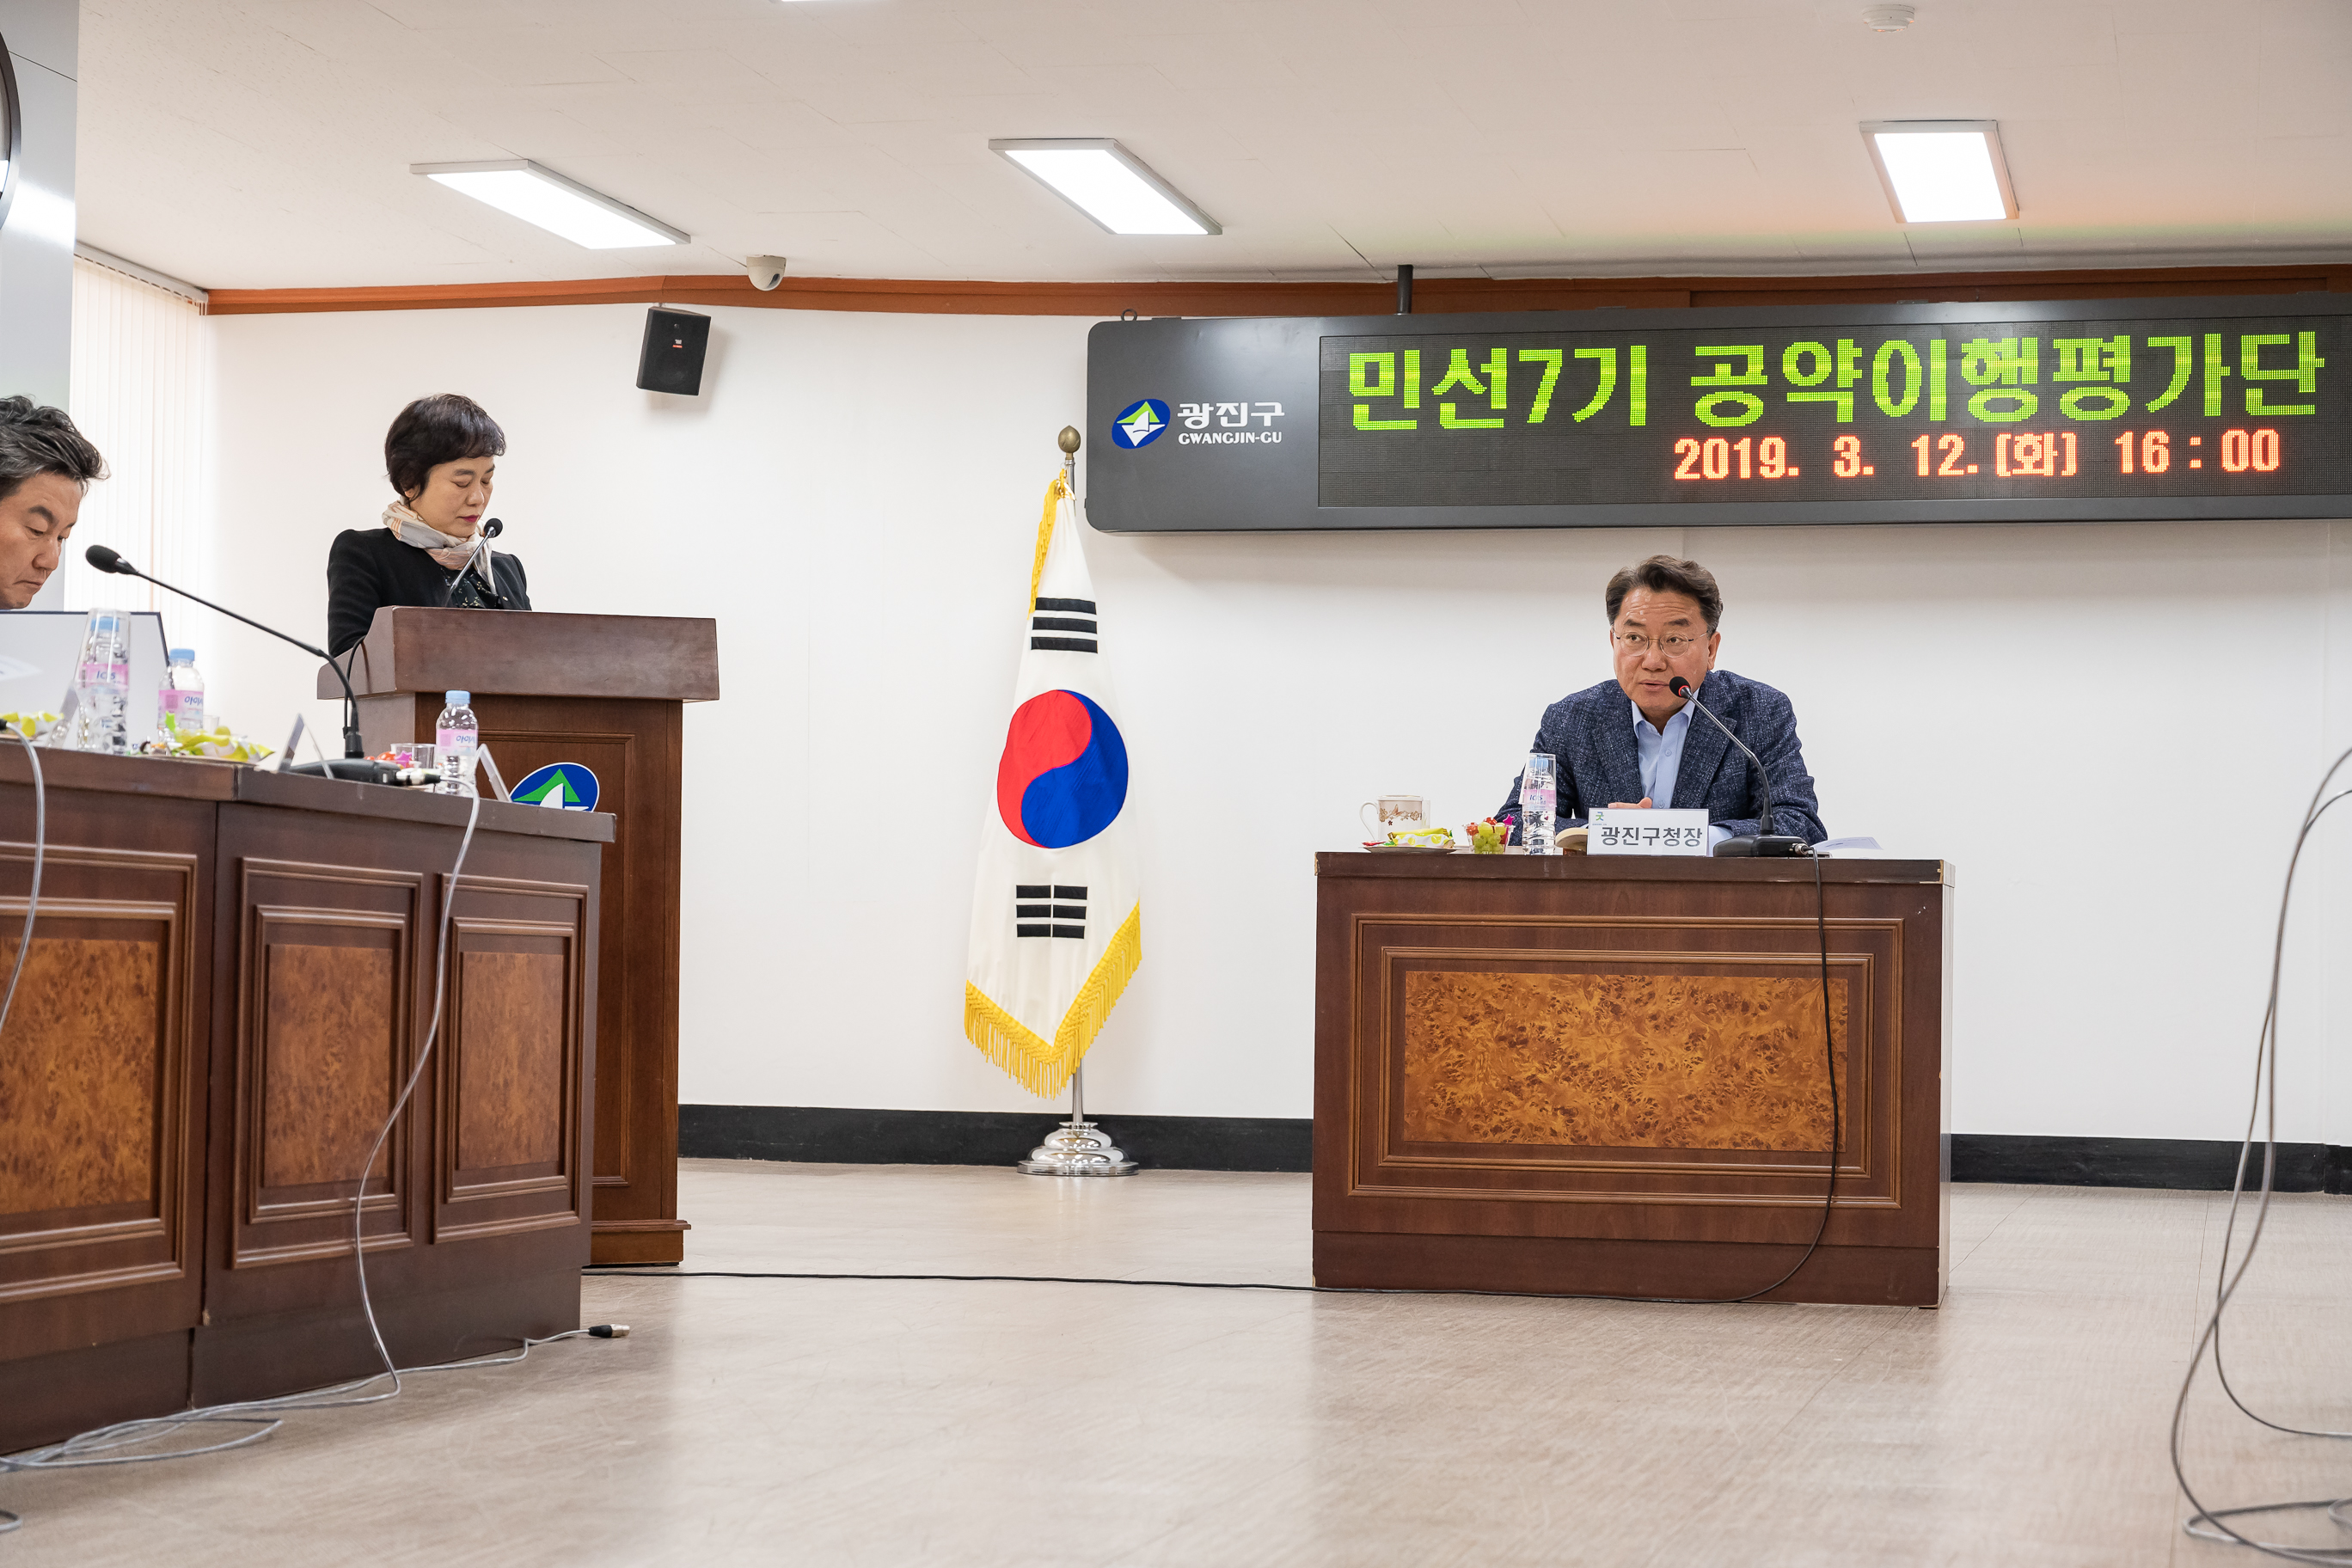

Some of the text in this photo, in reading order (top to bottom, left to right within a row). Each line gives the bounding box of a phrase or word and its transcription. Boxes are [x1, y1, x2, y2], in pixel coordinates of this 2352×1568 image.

[1349, 331, 2324, 431] 민선7기 공약이행평가단
[1177, 401, 1285, 430] 광진구
[1178, 432, 1283, 445] GWANGJIN-GU
[1673, 436, 1800, 481] 2019.
[1833, 433, 1875, 478] 3.
[1601, 826, 1703, 848] 광진구청장
